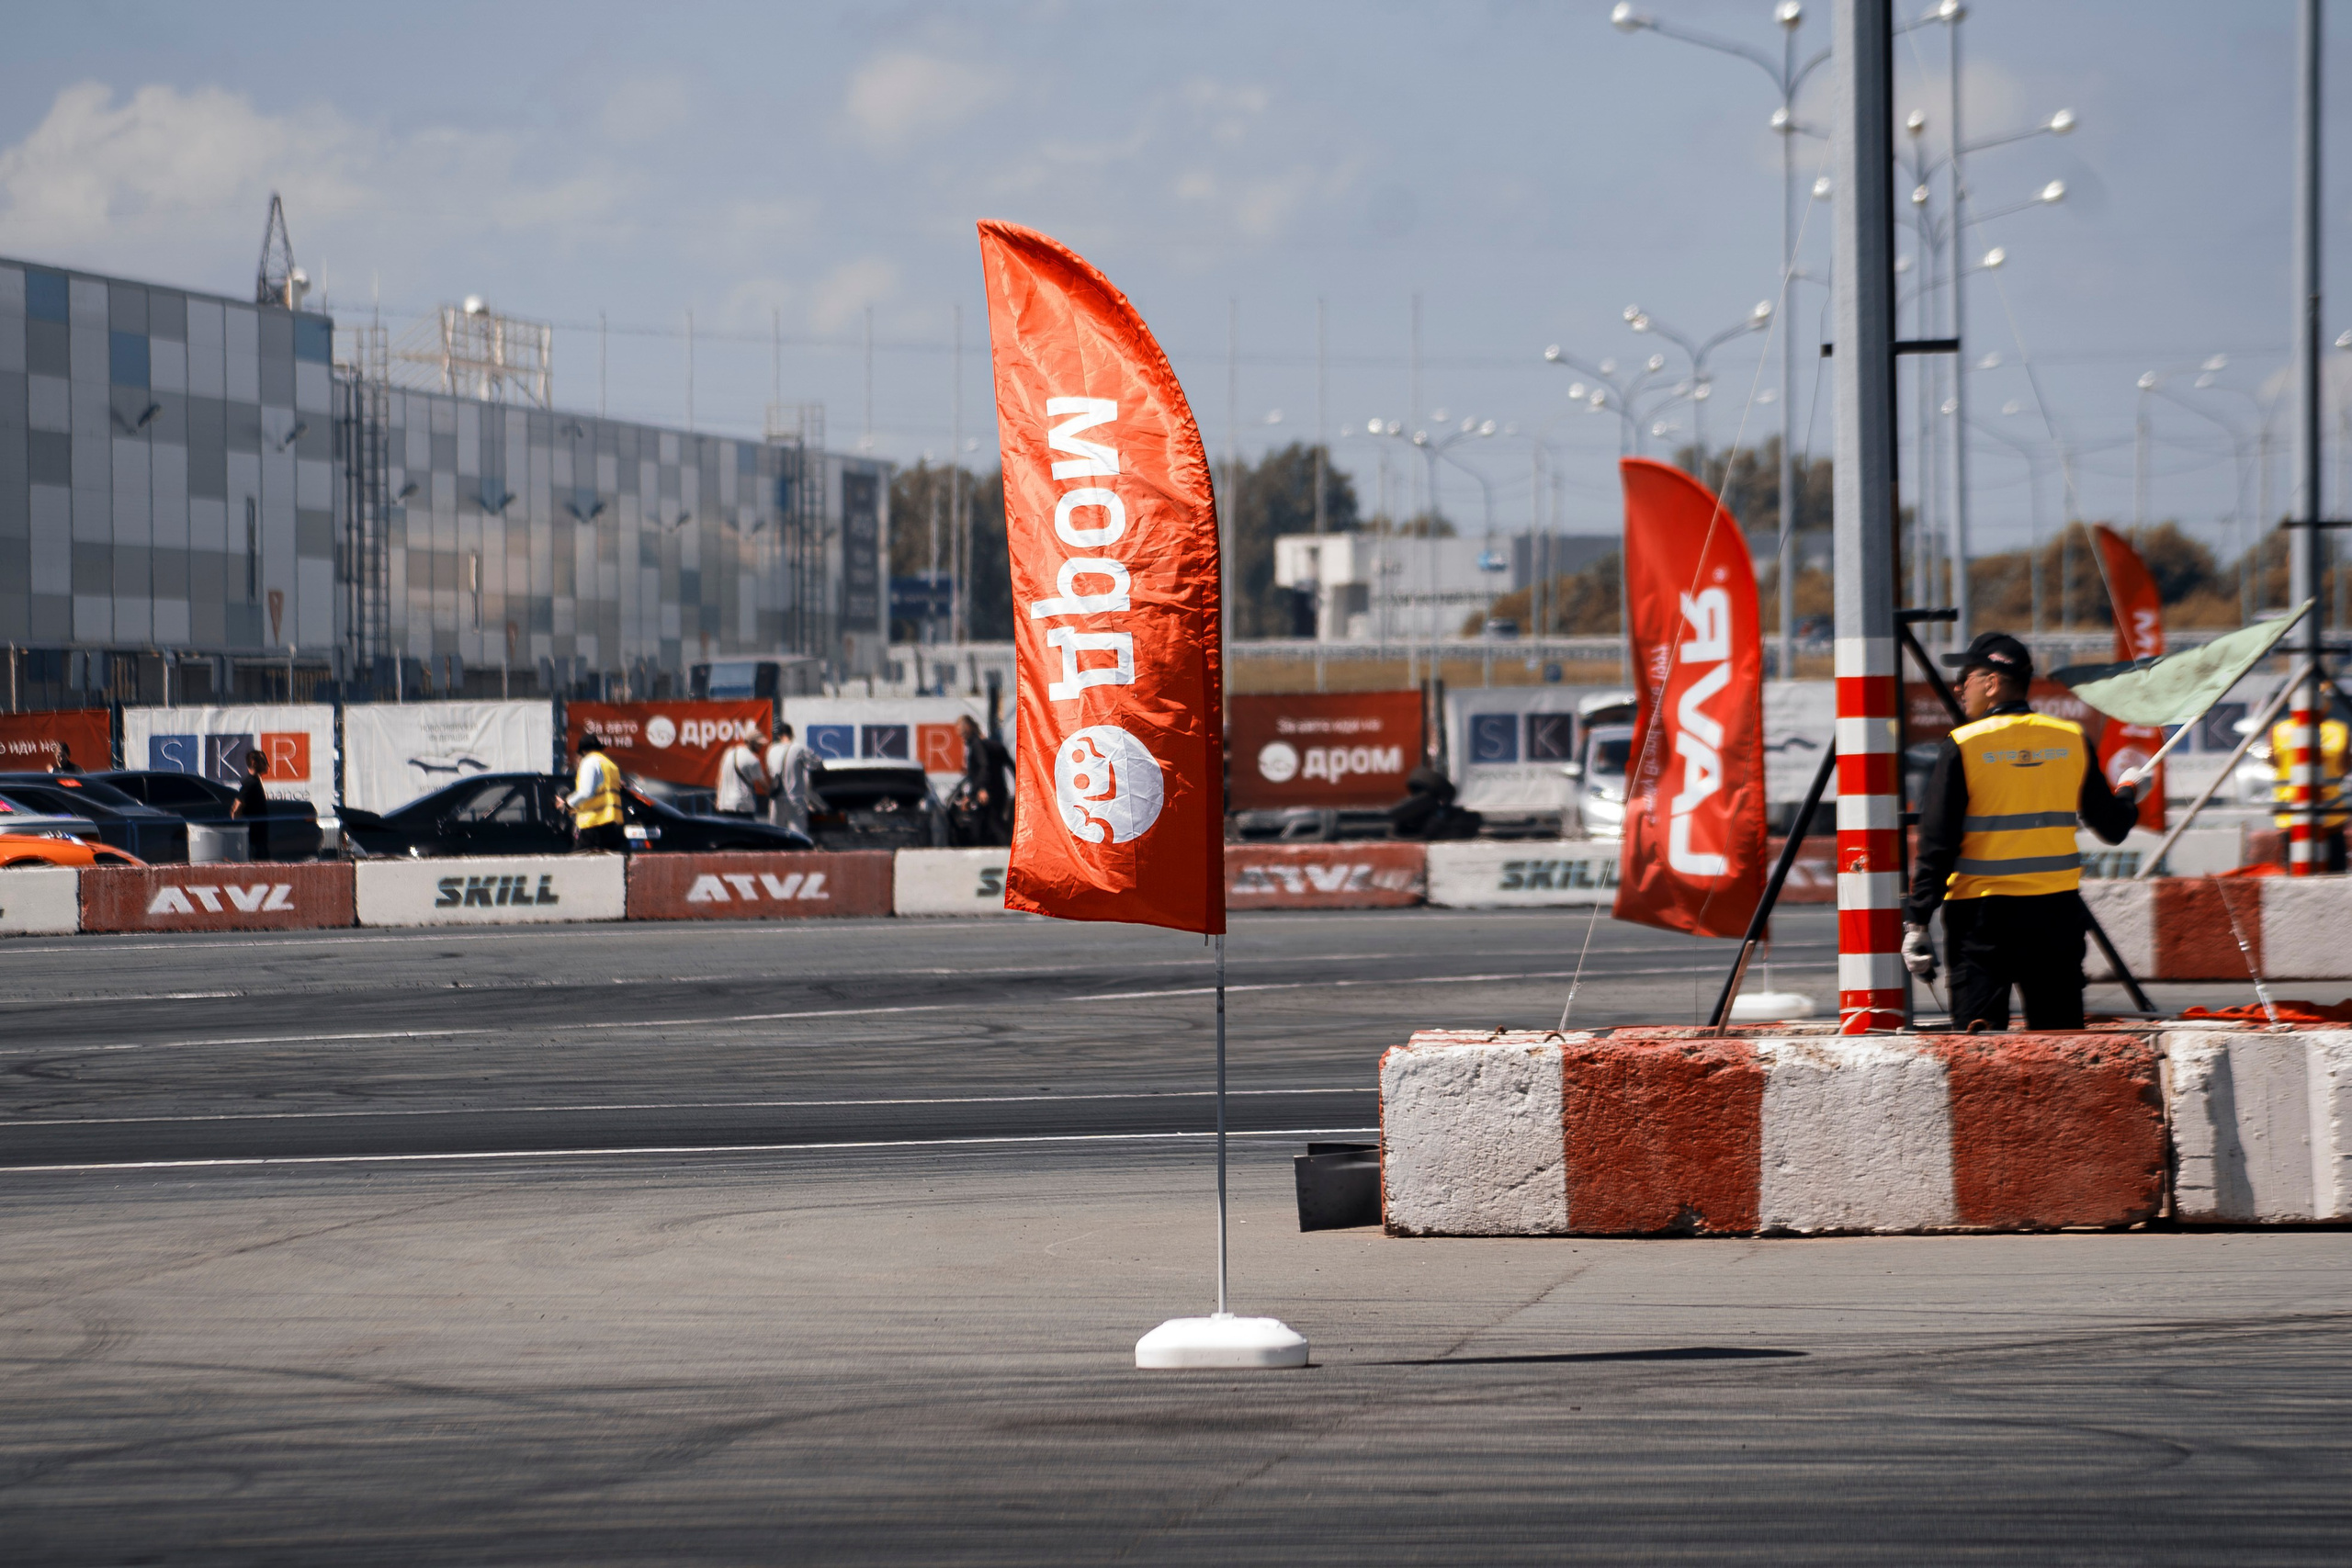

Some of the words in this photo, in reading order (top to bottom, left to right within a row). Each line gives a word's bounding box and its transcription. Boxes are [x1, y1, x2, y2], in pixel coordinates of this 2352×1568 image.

[583, 716, 603, 735] За
[605, 718, 639, 734] авто
[680, 718, 758, 750] дром
[8, 740, 38, 756] иди
[160, 737, 299, 778] SKR
[615, 735, 634, 749] на
[1302, 746, 1404, 784] дром
[435, 874, 560, 908] SKILL
